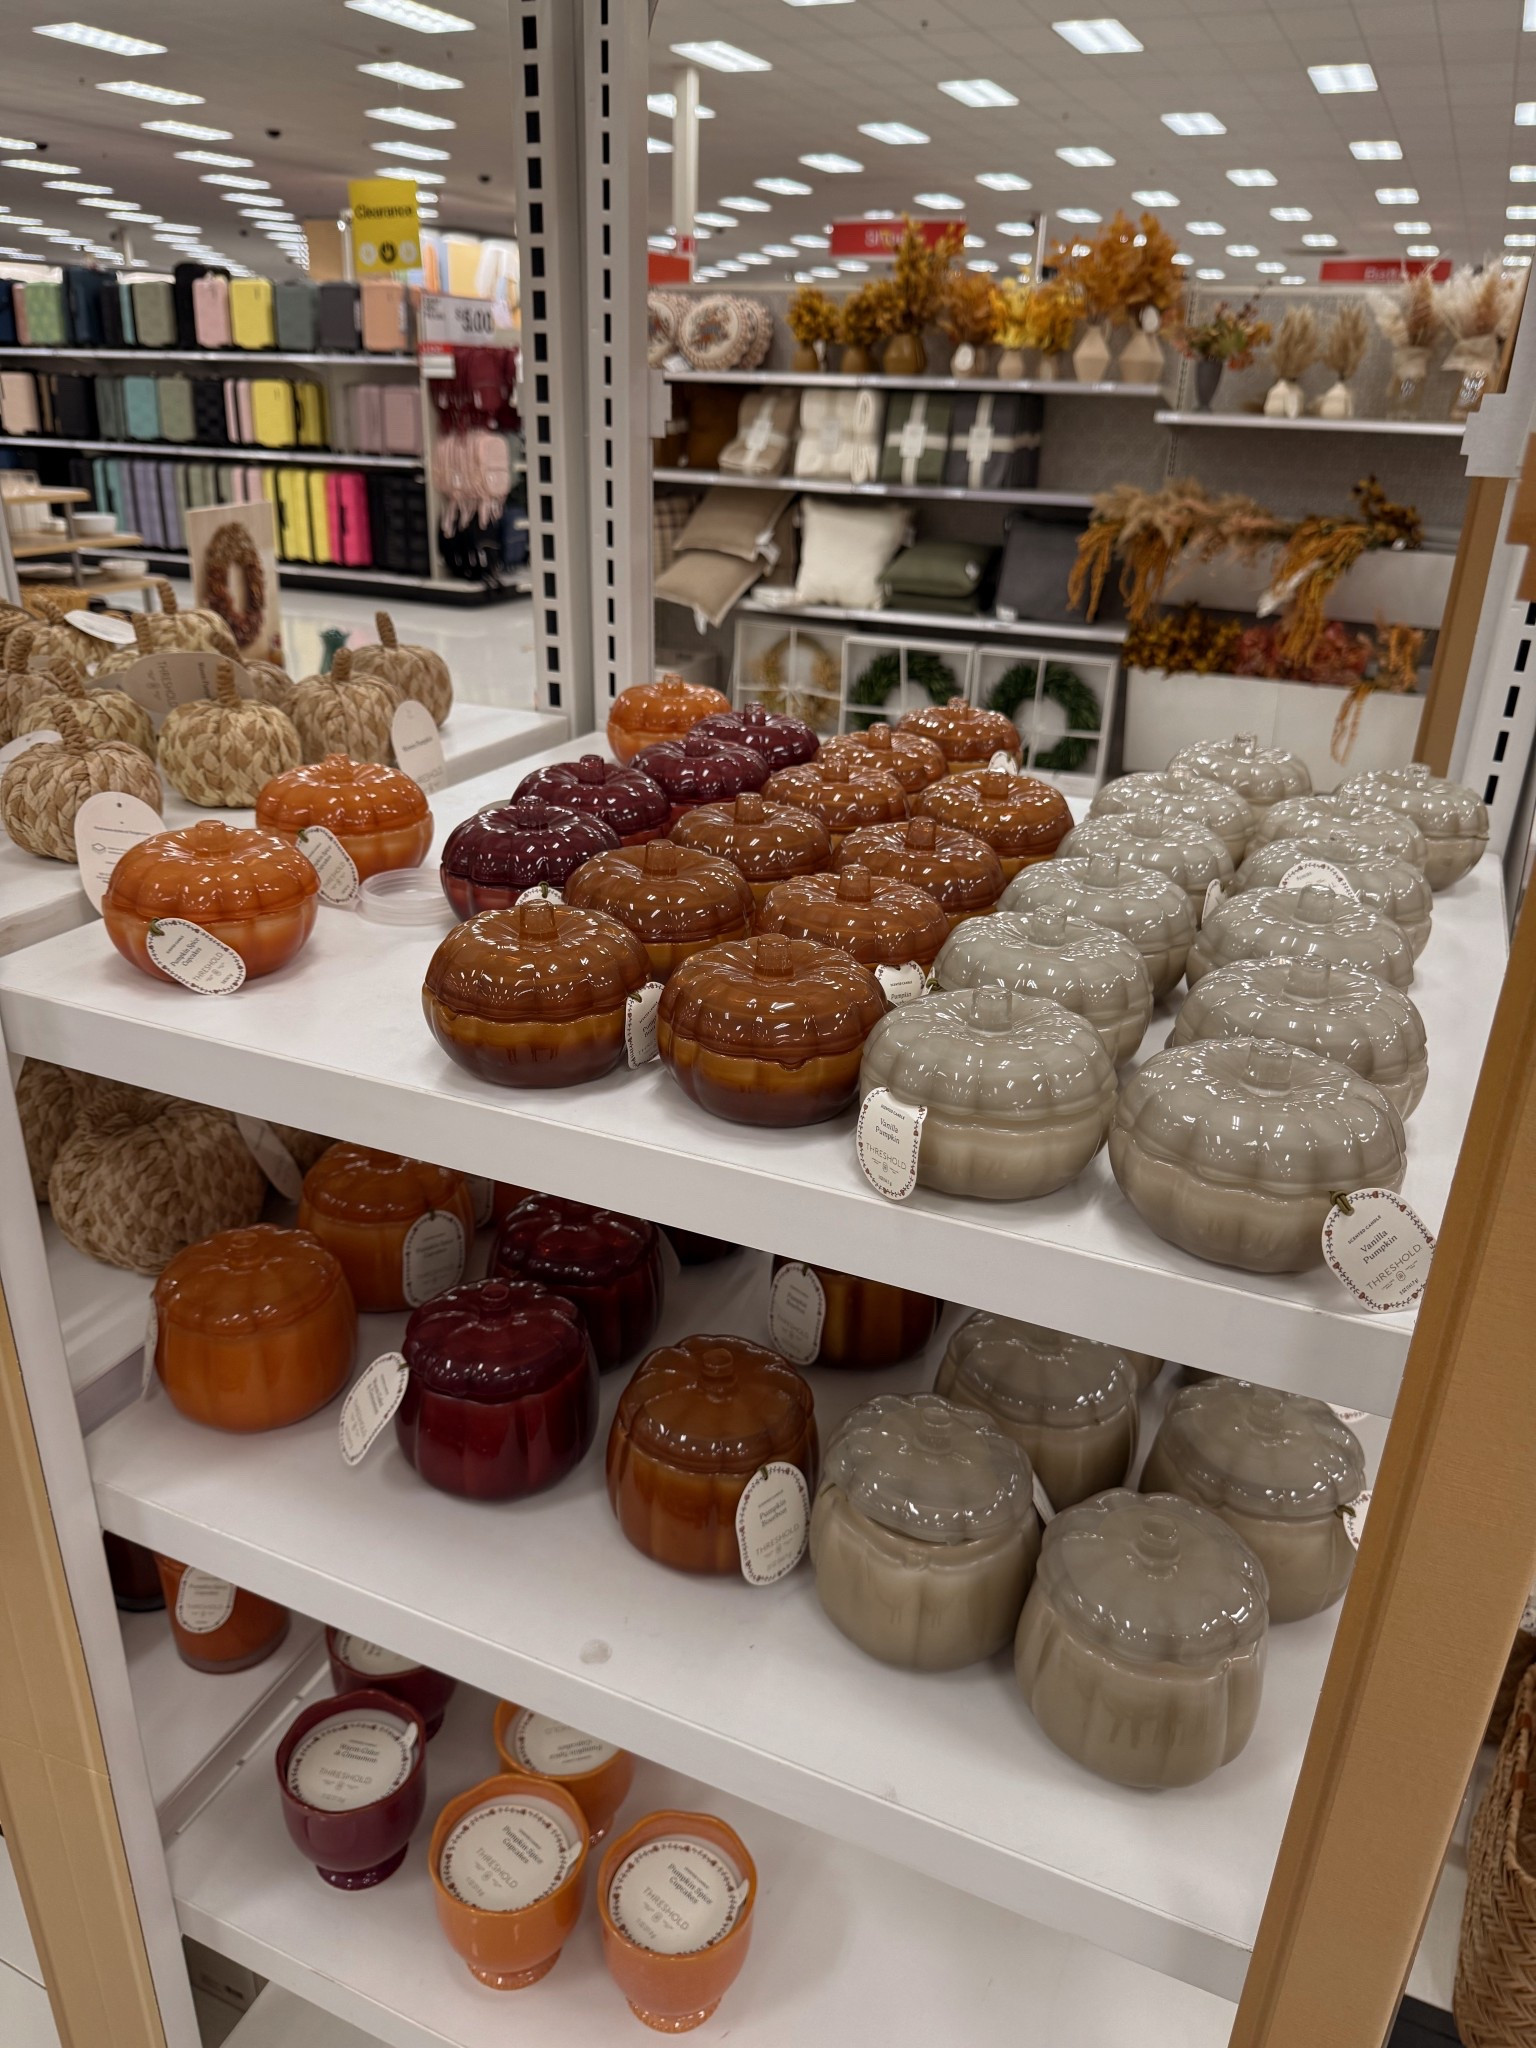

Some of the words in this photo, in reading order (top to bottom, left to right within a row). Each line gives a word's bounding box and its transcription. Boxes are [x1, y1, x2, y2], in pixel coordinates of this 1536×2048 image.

[170, 947, 191, 967] Pumpkin
[187, 937, 200, 950] Spice
[182, 947, 202, 967] Cupcakes
[192, 952, 223, 981] THRESHOLD
[890, 992, 912, 1000] Pumpkin
[875, 1125, 901, 1144] Pumpkin
[880, 1117, 899, 1133] Vanilla
[865, 1142, 907, 1170] THRESHOLD
[1347, 1227, 1366, 1245] SCENTED
[1364, 1214, 1382, 1230] CANDLE
[1360, 1229, 1388, 1253] Vanilla
[1362, 1234, 1398, 1264] Pumpkin
[1366, 1244, 1422, 1290] THRESHOLD
[759, 1499, 786, 1520] Pumpkin
[756, 1522, 800, 1555] THRESHOLD
[320, 1767, 373, 1785] THRESHOLD
[502, 1825, 528, 1853] Pumpkin
[502, 1838, 529, 1864] Cupcakes
[476, 1847, 519, 1889] THRESHOLD
[667, 1863, 695, 1890] Pumpkin
[694, 1887, 713, 1905] Spice
[669, 1876, 699, 1904] Cupcakes
[643, 1886, 690, 1931] THRESHOLD
